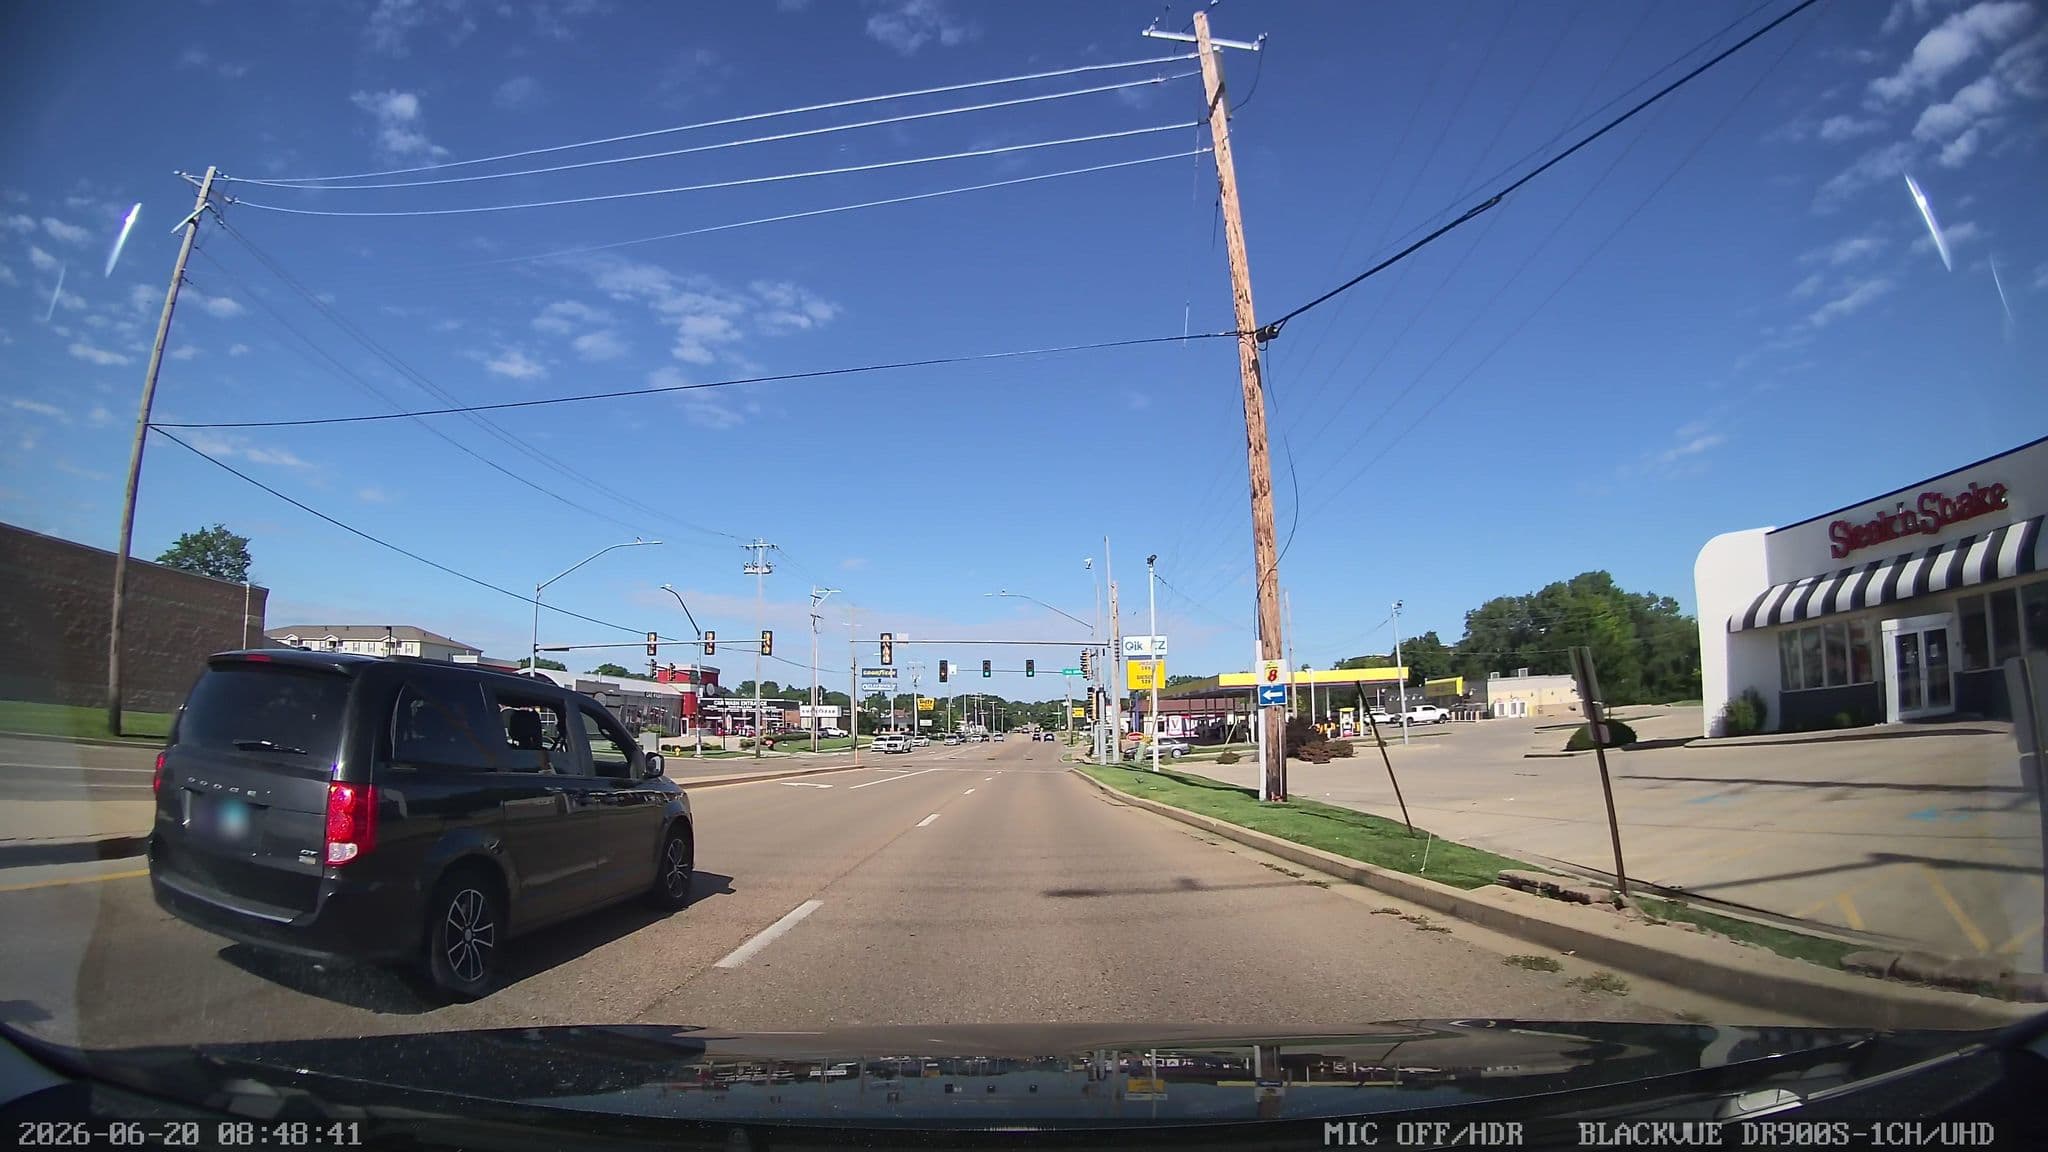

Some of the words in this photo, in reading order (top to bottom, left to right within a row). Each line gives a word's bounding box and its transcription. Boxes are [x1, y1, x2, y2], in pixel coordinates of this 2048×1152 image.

[1917, 482, 2009, 535] Shake
[1125, 641, 1144, 652] Qik
[1267, 669, 1279, 682] 8
[187, 776, 257, 798] DODGE
